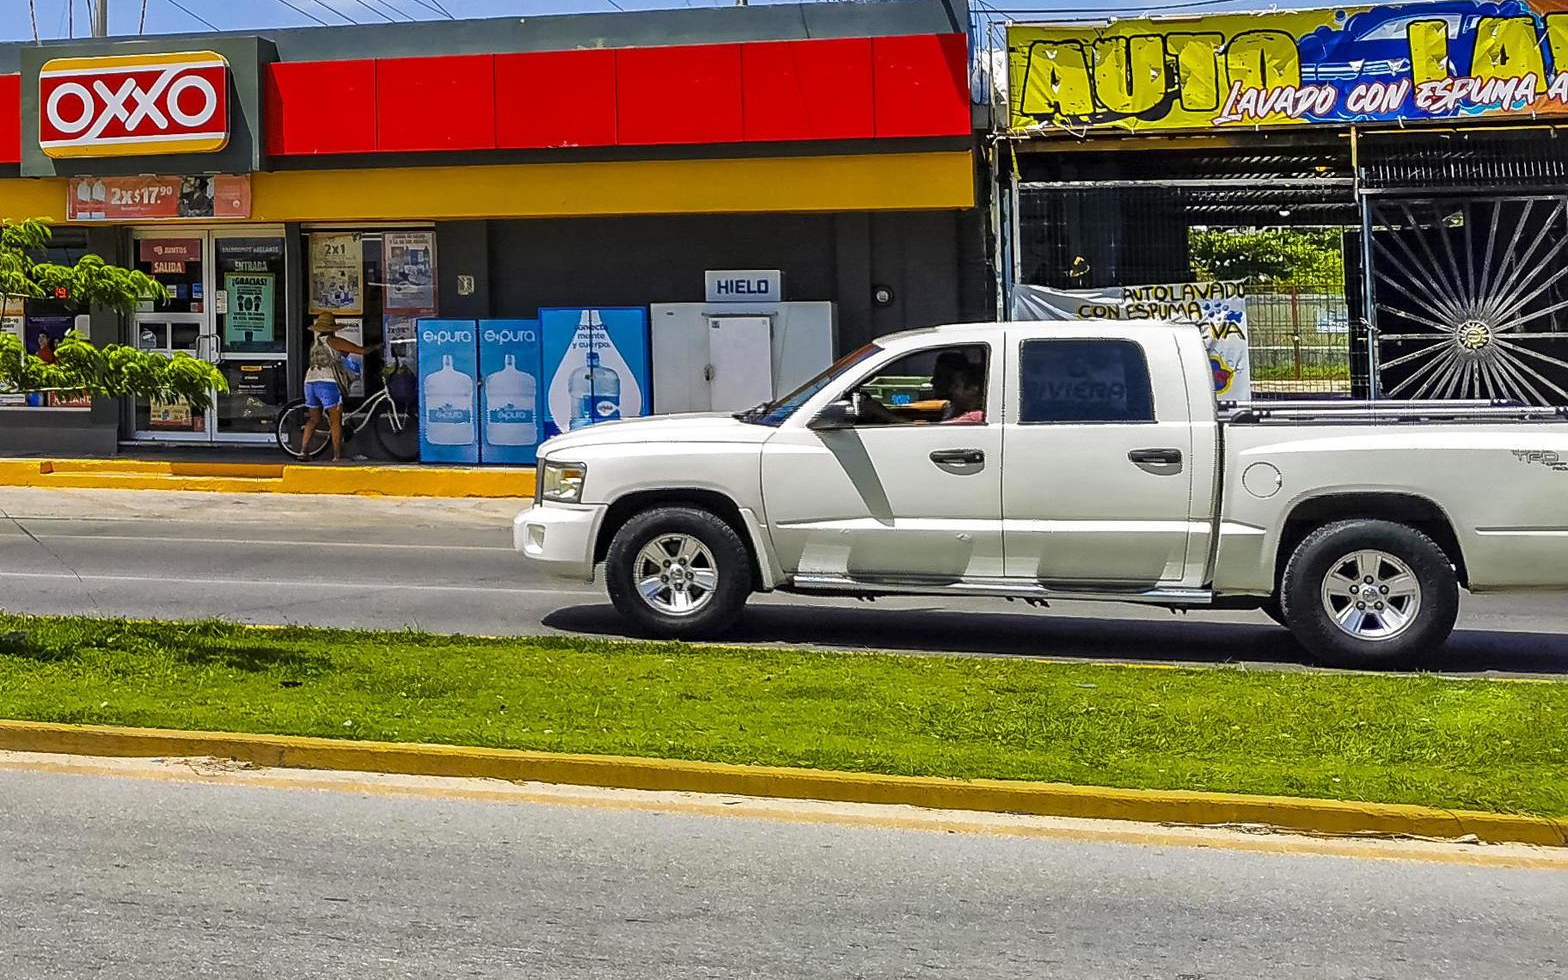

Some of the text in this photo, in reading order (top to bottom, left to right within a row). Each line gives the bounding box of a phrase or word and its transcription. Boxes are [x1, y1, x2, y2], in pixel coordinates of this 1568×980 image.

[1022, 29, 1303, 117] AUTO
[46, 70, 217, 138] OXXO
[1213, 79, 1336, 125] LAVADO
[1347, 78, 1412, 114] CON
[1416, 72, 1538, 113] ESPUMA
[324, 243, 346, 255] 2x1
[154, 261, 183, 273] SALIDA
[234, 260, 268, 272] ENTRADA
[231, 277, 268, 287] ¡GRACIAS!
[716, 279, 770, 294] HIELO
[1077, 302, 1203, 321] CON ESPUMA
[1511, 449, 1559, 464] TRD
